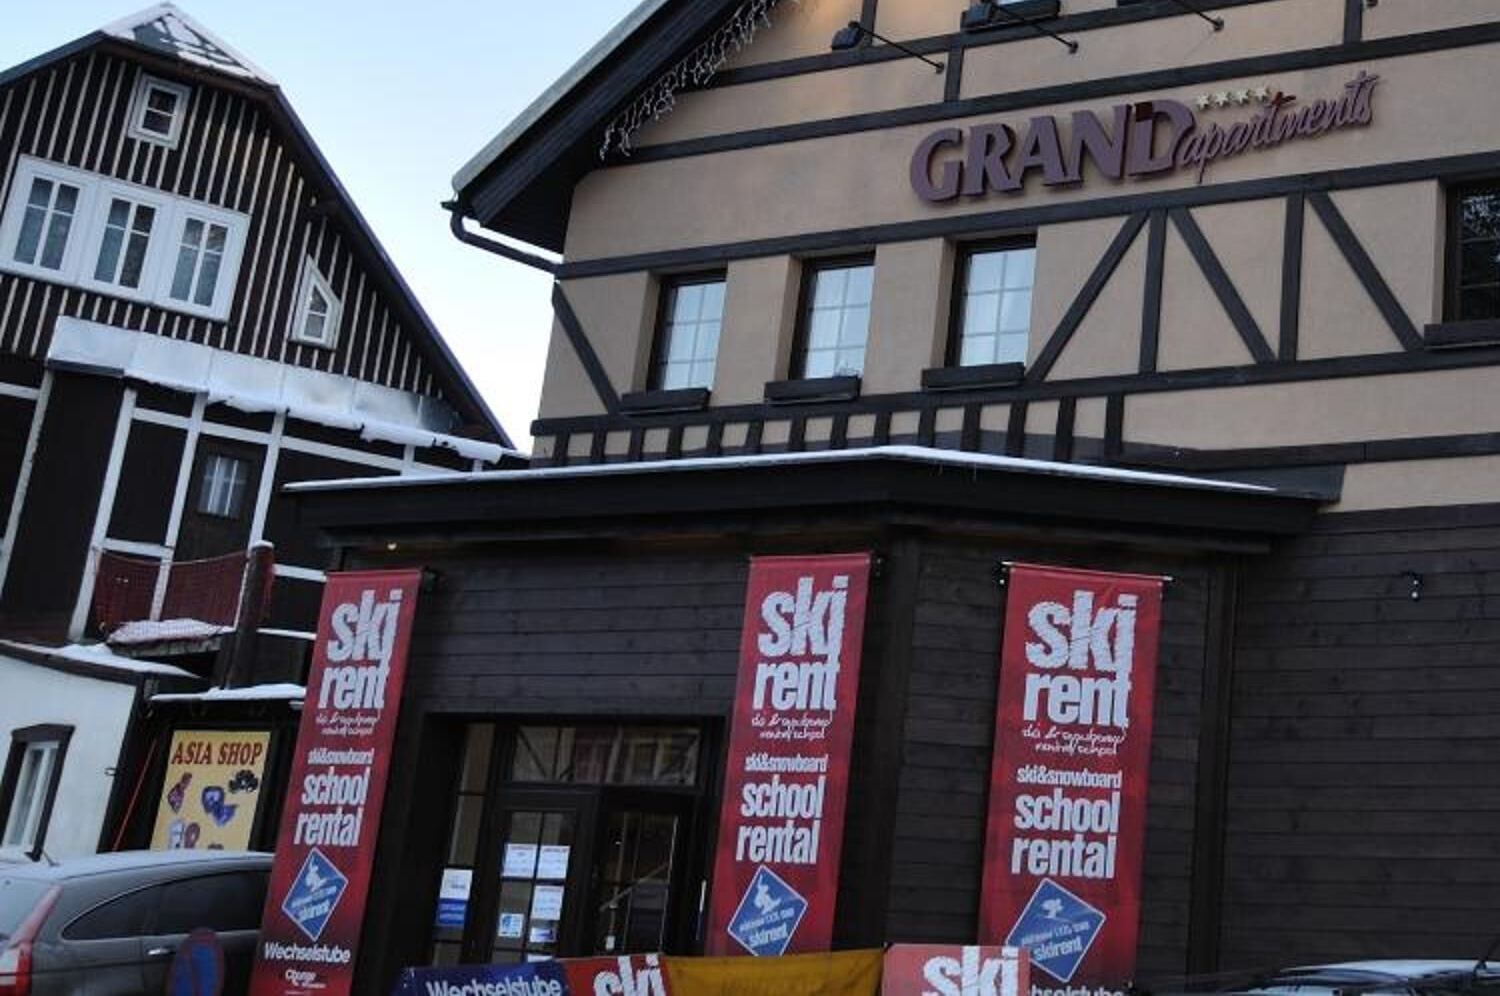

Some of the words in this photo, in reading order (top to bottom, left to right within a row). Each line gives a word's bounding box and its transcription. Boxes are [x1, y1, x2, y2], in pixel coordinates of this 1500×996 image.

[910, 99, 1195, 202] GRAND
[1181, 69, 1379, 183] apartments
[327, 589, 403, 663] ski
[757, 576, 849, 658] ski
[1025, 590, 1138, 671] ski
[317, 665, 390, 711] rent
[752, 661, 840, 712] rent
[1023, 672, 1131, 728] rent
[171, 741, 213, 765] ASIA
[217, 742, 263, 765] SHOP
[301, 765, 370, 805] school
[741, 773, 826, 818] school
[1016, 764, 1122, 789] ski&snowboard
[293, 806, 363, 846] rental
[1014, 787, 1121, 833] school
[735, 819, 820, 865] rental
[1011, 834, 1117, 879] rental
[264, 942, 351, 964] Wechselstube
[921, 945, 1019, 996] ski
[1033, 935, 1084, 961] skirent
